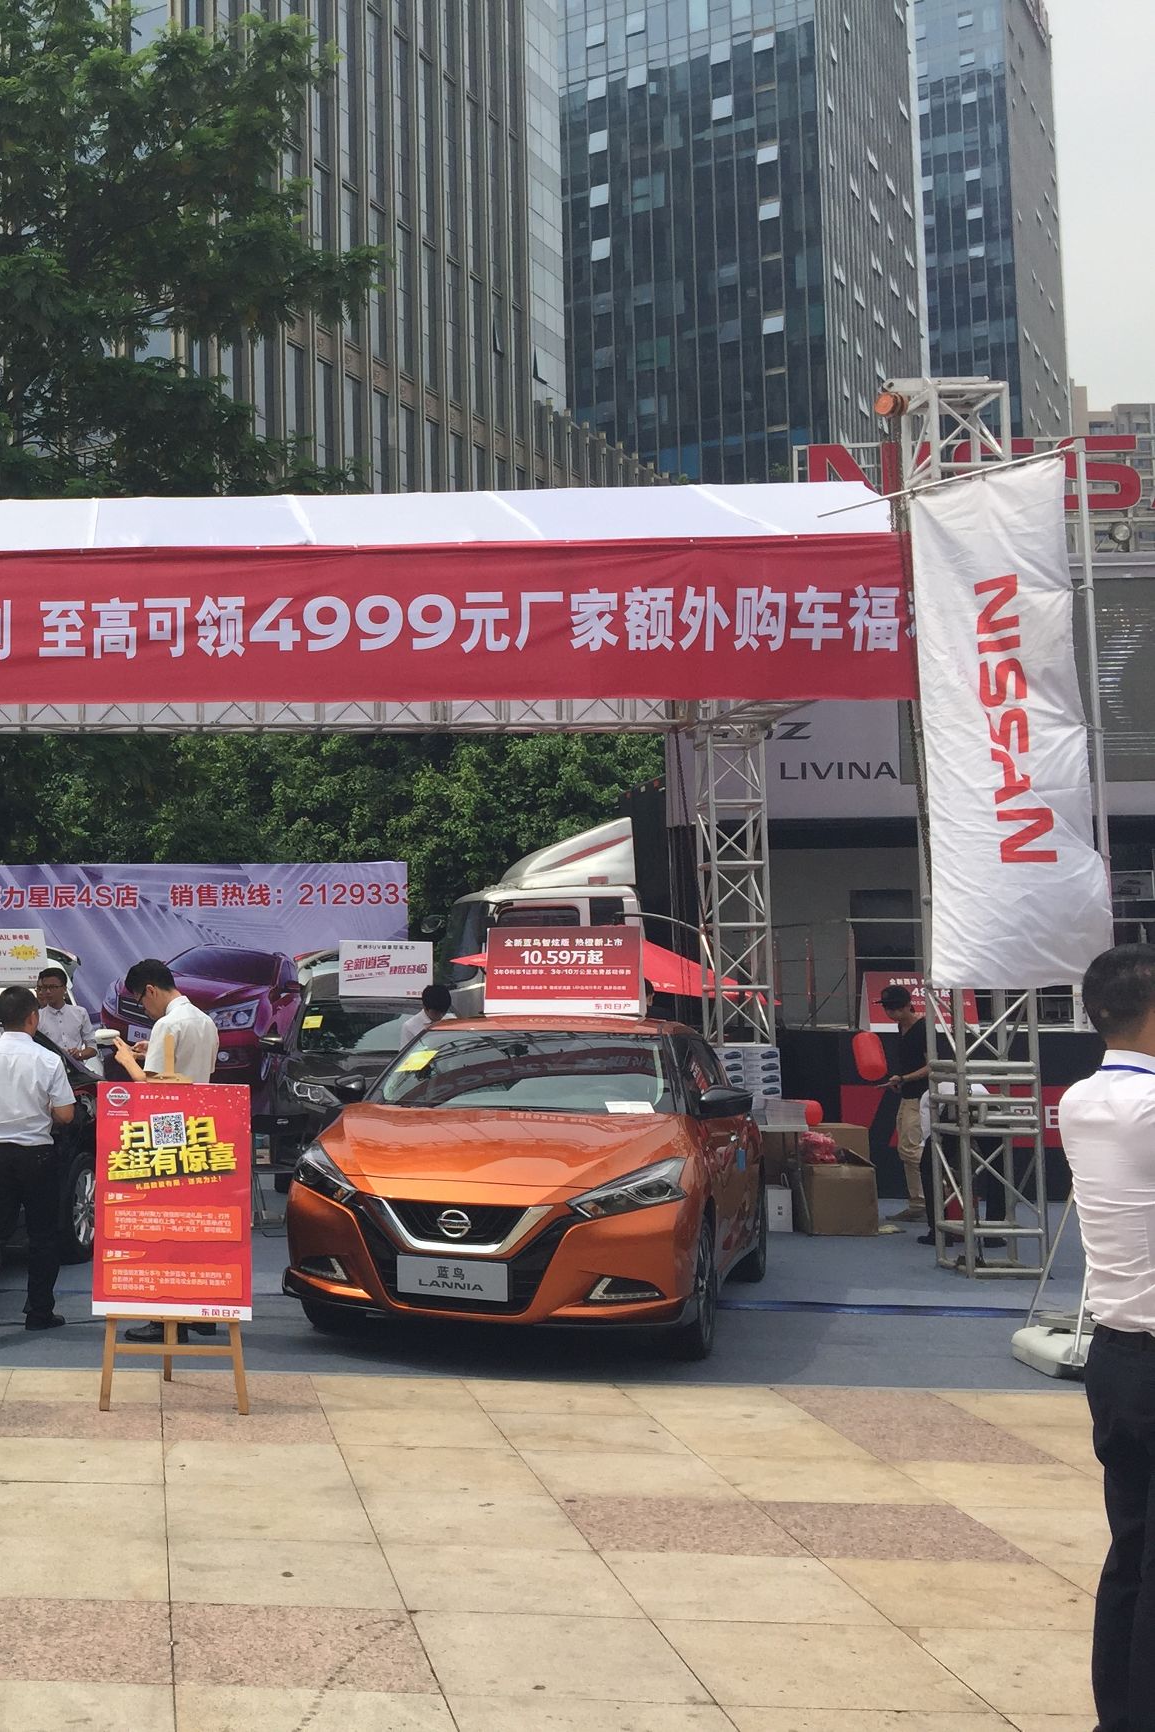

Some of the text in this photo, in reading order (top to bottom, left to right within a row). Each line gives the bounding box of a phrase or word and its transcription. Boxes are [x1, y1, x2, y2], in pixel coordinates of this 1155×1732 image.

[38, 585, 916, 660] 至高可领4999元厂家额外购车福
[974, 574, 1058, 863] NISSAN
[780, 761, 897, 780] LIVINA
[520, 950, 604, 965] 10.59万起
[120, 1115, 218, 1150] 扫 扫
[437, 1265, 466, 1281] 蓝鸟
[418, 1278, 485, 1292] LANNIA
[201, 1308, 241, 1318] 东风日产
